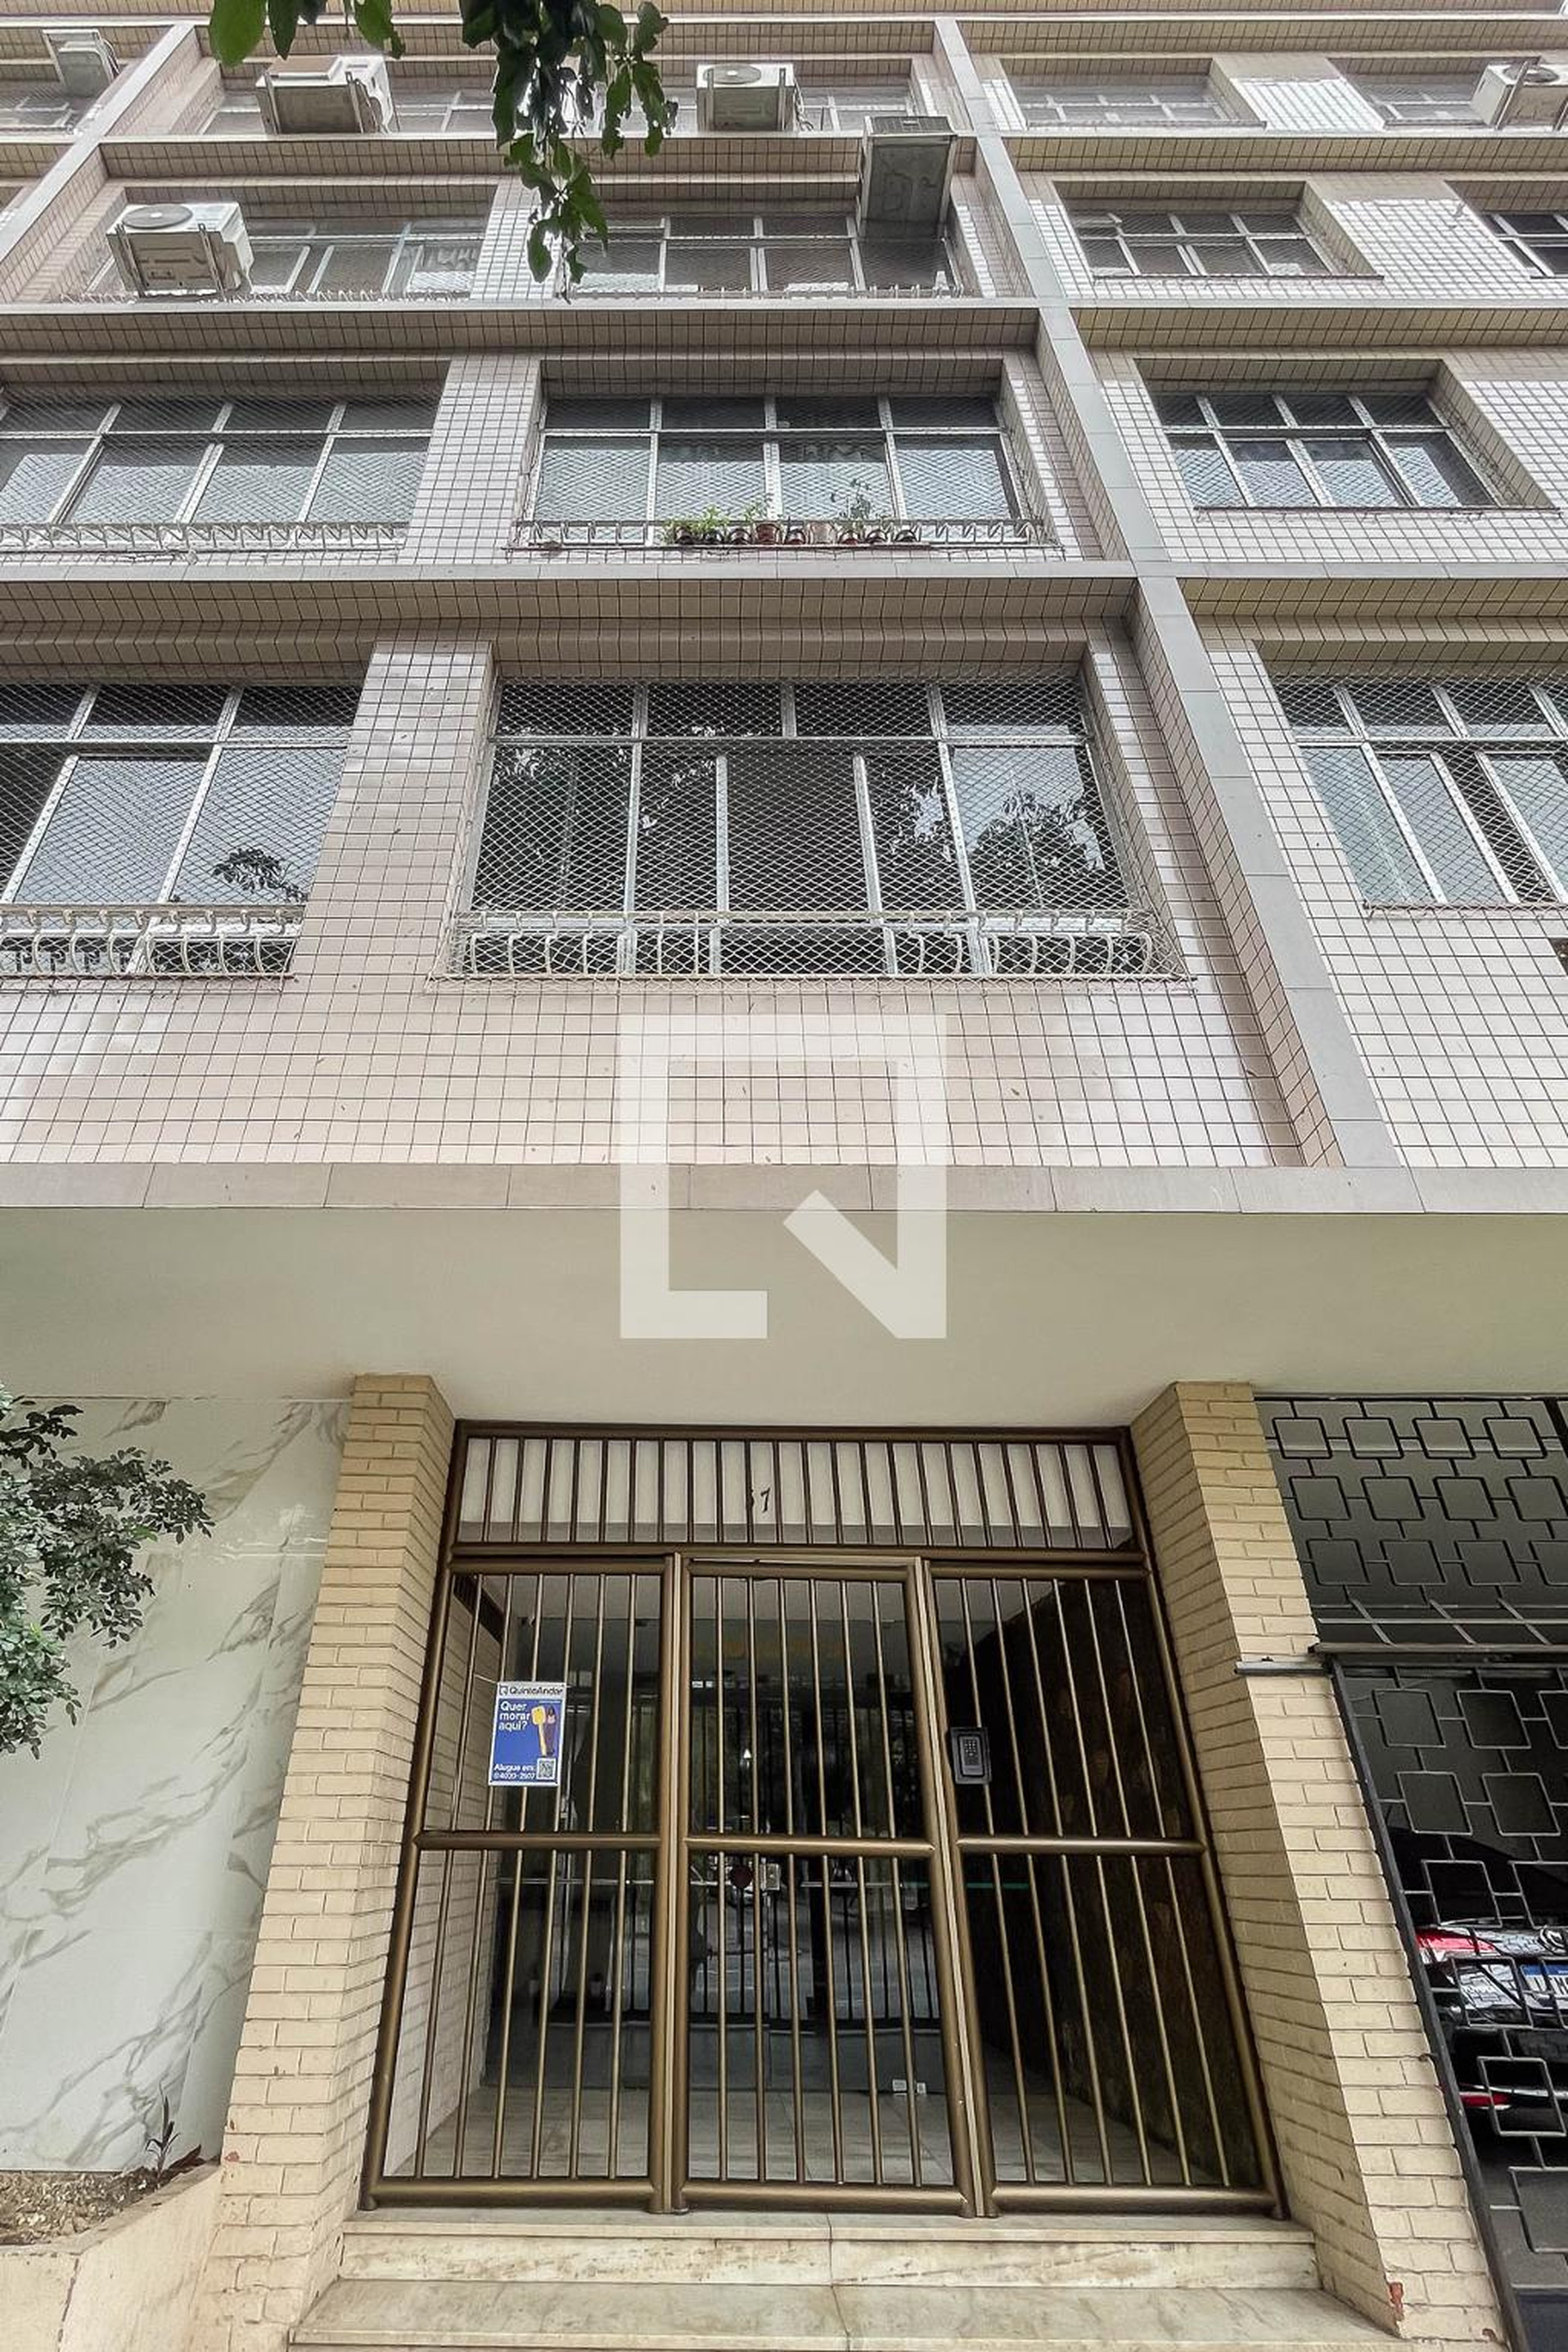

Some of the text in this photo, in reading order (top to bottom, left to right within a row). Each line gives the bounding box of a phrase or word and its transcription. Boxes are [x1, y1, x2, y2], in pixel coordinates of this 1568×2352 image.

[500, 1701, 527, 1711] Quer
[499, 1713, 531, 1721] morar
[498, 1721, 528, 1732] aqui?
